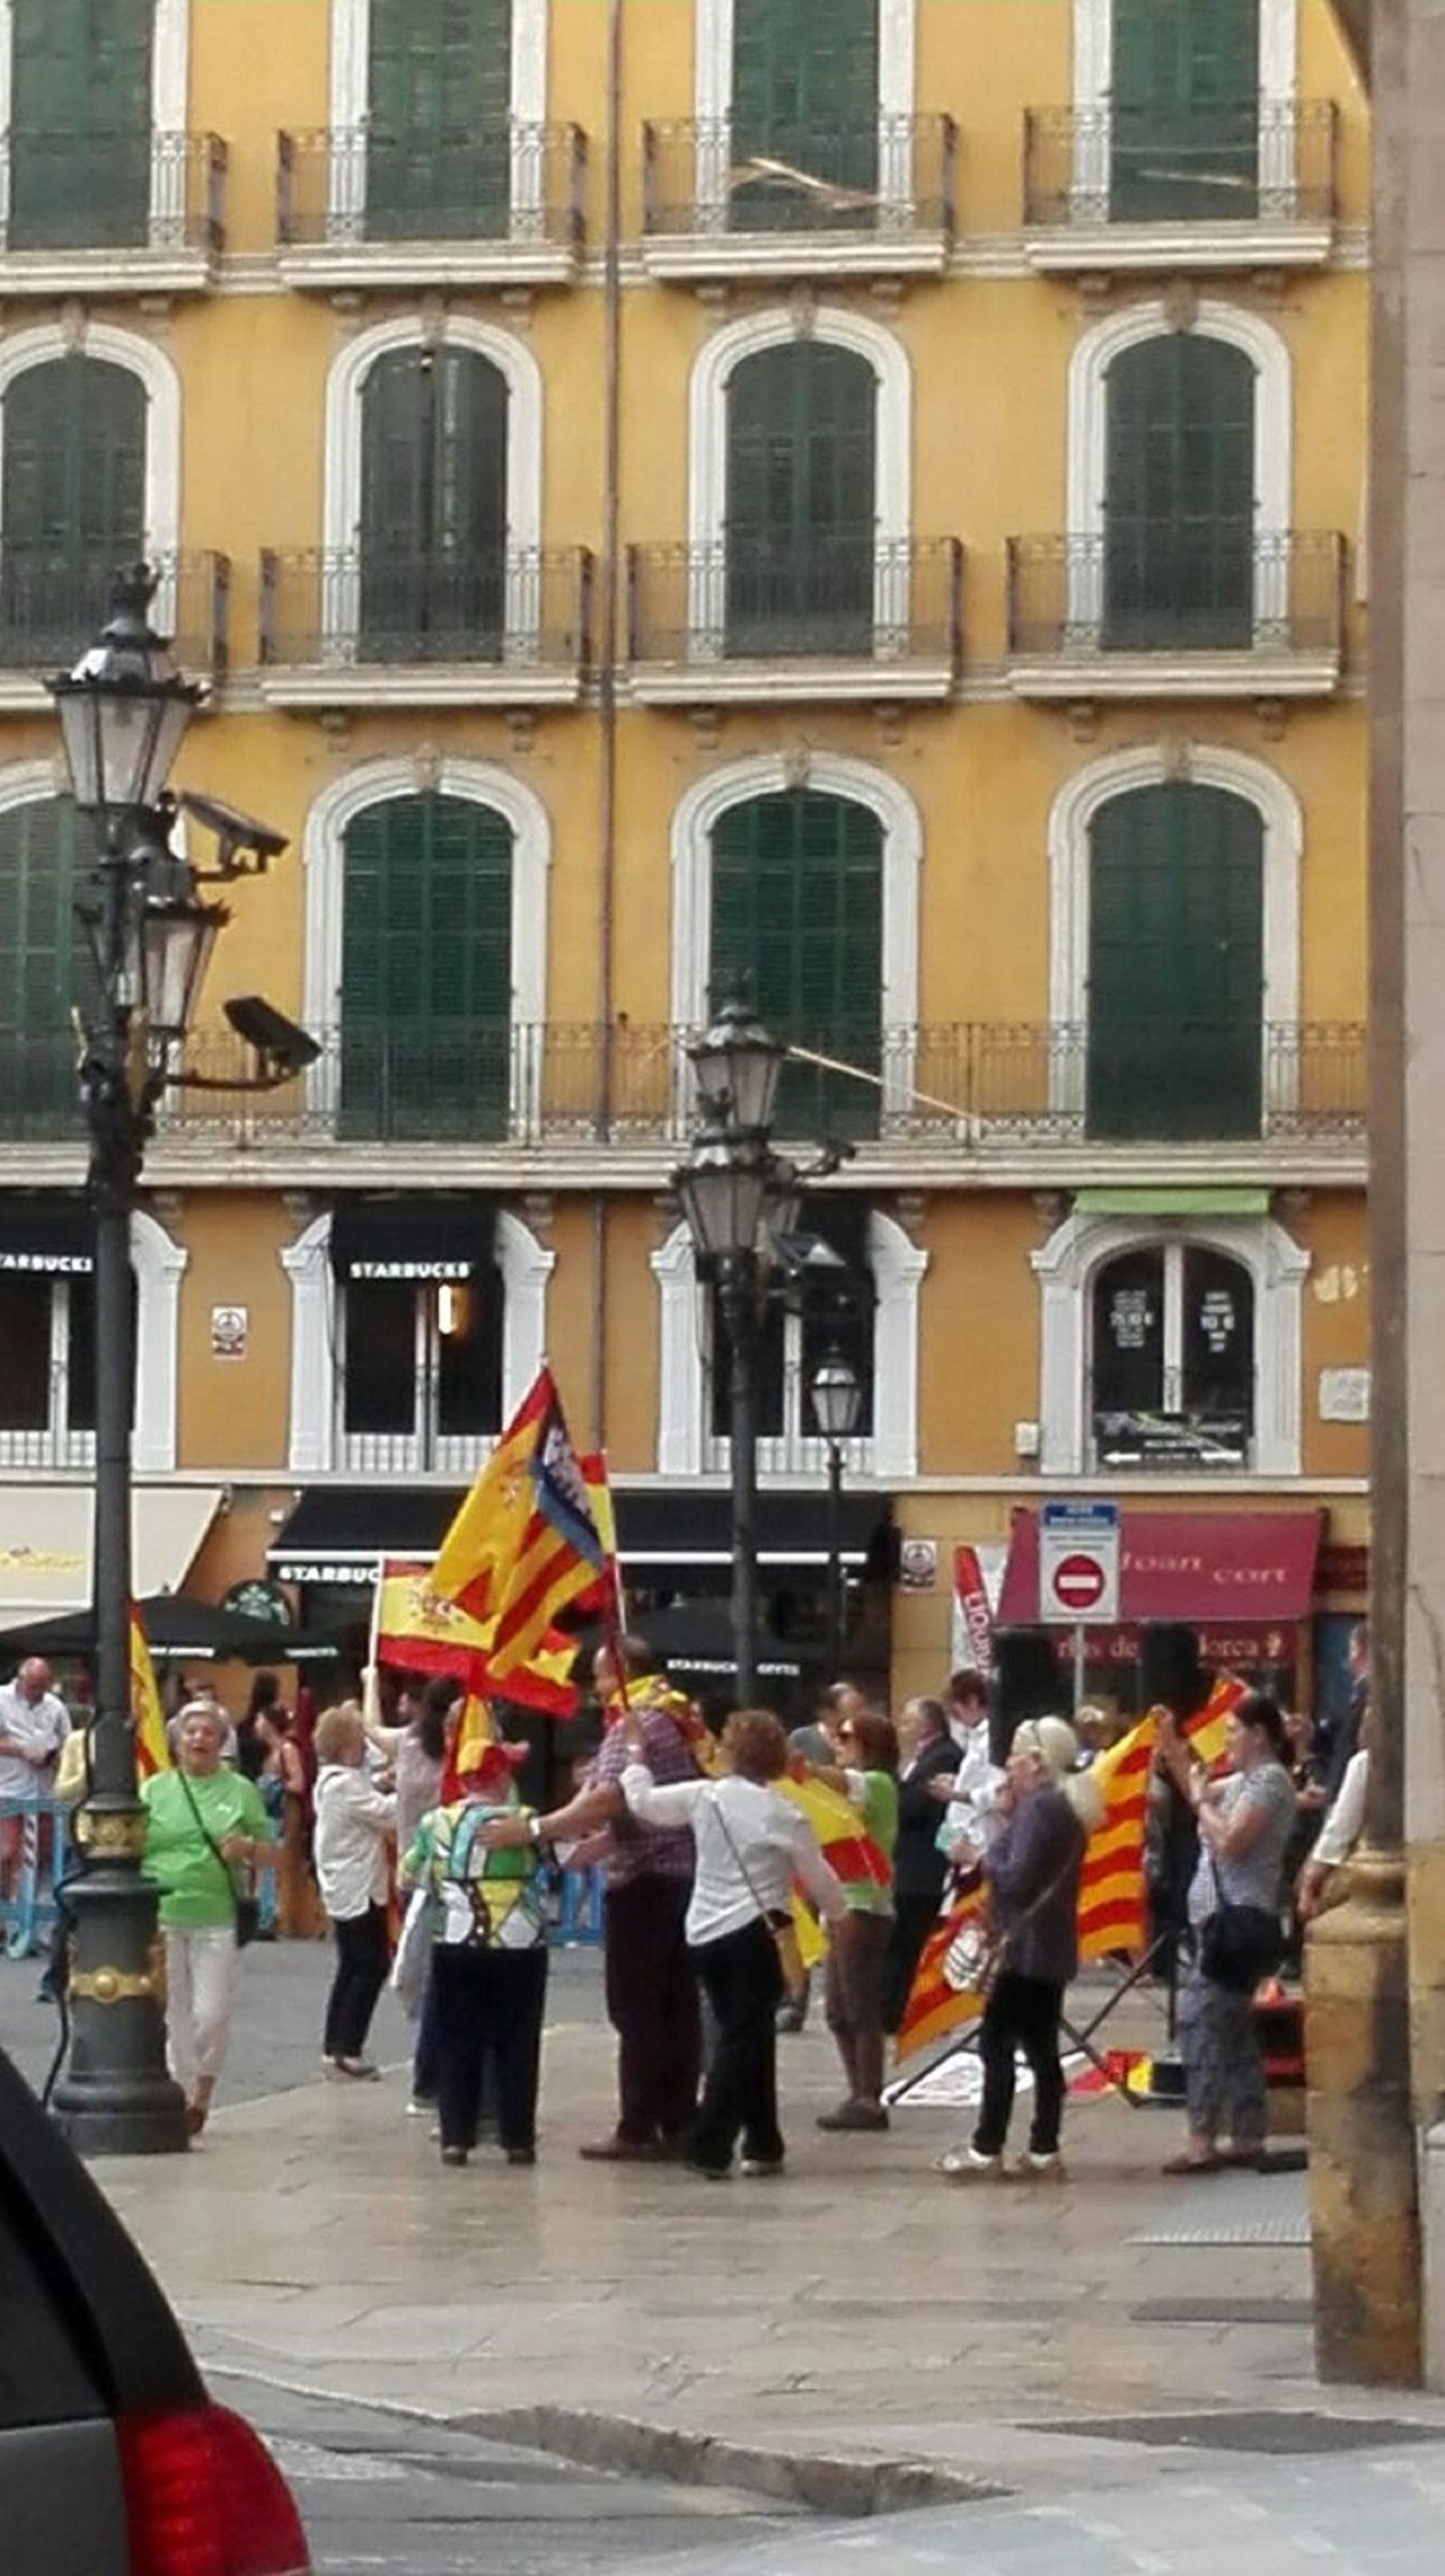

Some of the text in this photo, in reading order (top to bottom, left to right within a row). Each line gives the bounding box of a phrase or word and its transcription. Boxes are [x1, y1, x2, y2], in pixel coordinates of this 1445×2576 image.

[0, 1255, 93, 1271] ARBUCKS
[350, 1262, 470, 1279] STARBUCKS
[279, 1565, 379, 1583] STARBUC
[667, 1658, 740, 1673] STARBUCK
